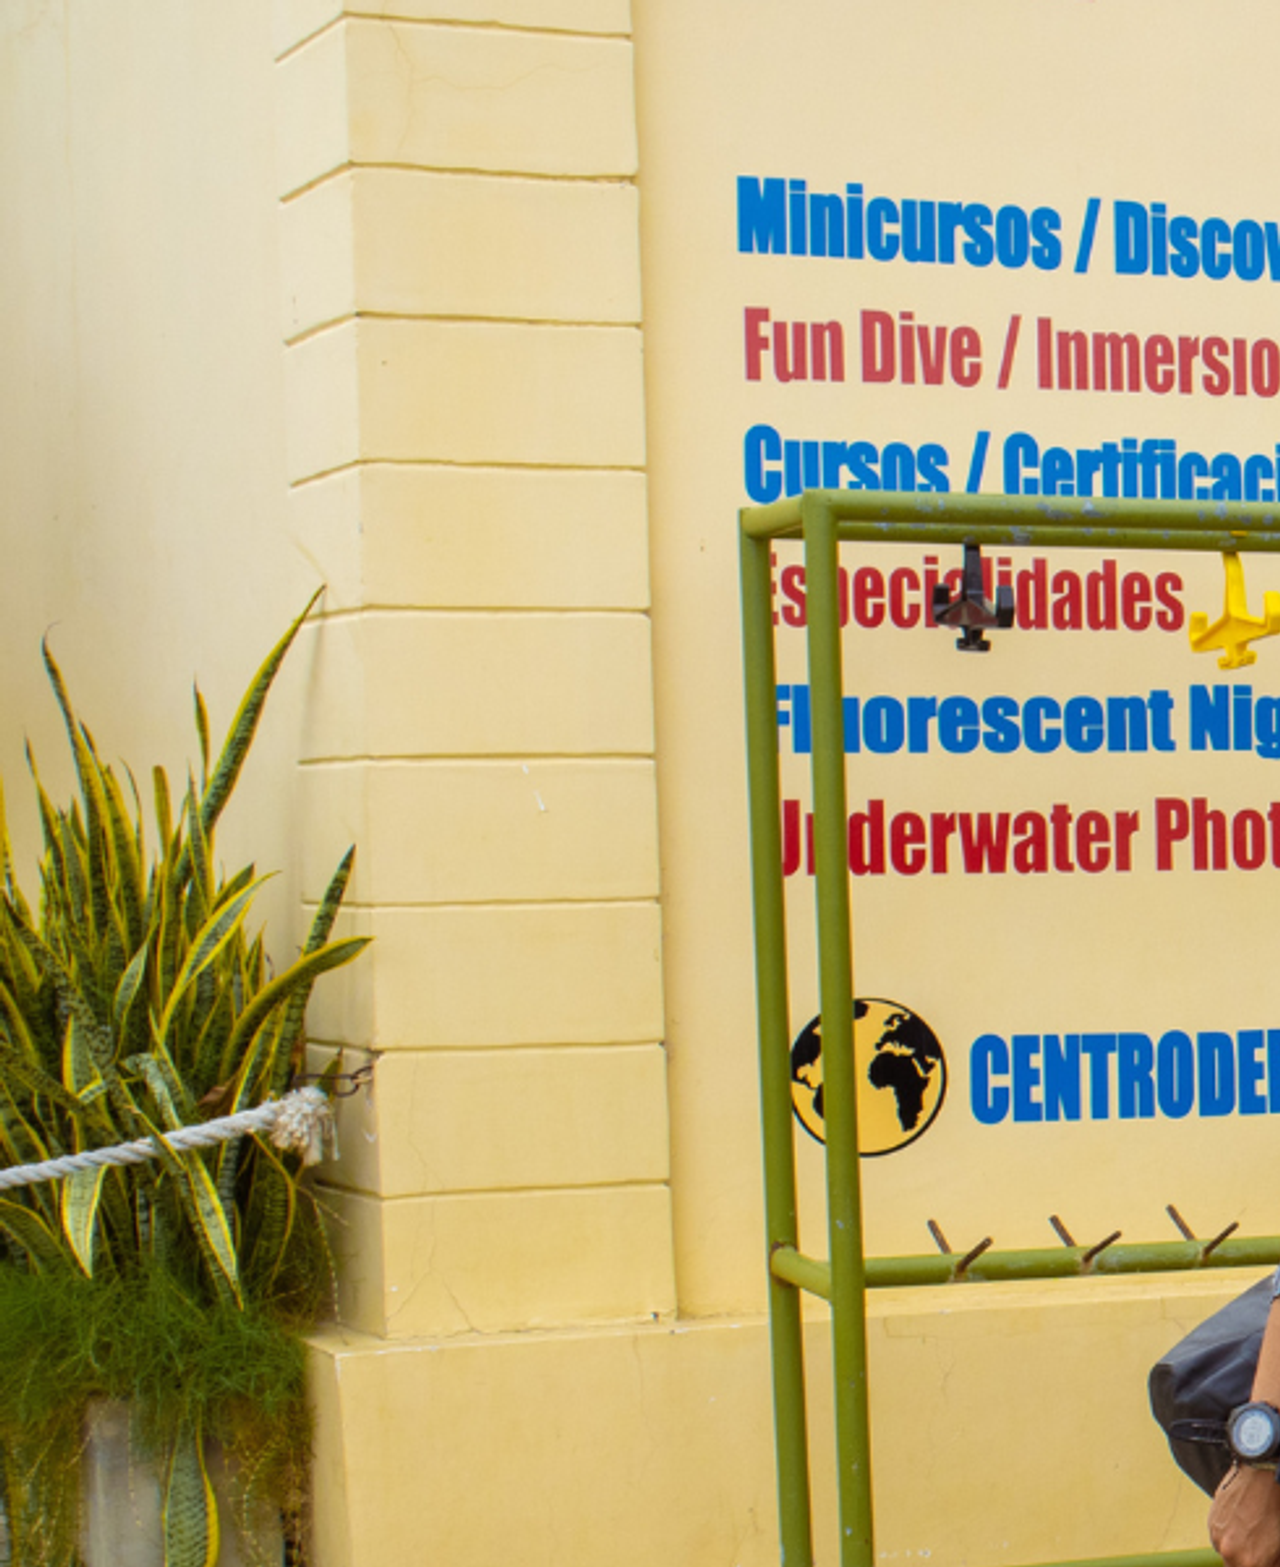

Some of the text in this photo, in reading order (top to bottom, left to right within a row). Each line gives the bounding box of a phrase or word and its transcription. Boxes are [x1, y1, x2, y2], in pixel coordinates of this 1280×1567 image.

[737, 175, 1062, 271] Minicursos
[1075, 197, 1102, 274] /
[744, 307, 844, 383] Fun
[861, 310, 982, 387] Dive
[998, 315, 1021, 389] /
[744, 424, 950, 504] Cursos
[770, 553, 1185, 632] secidades
